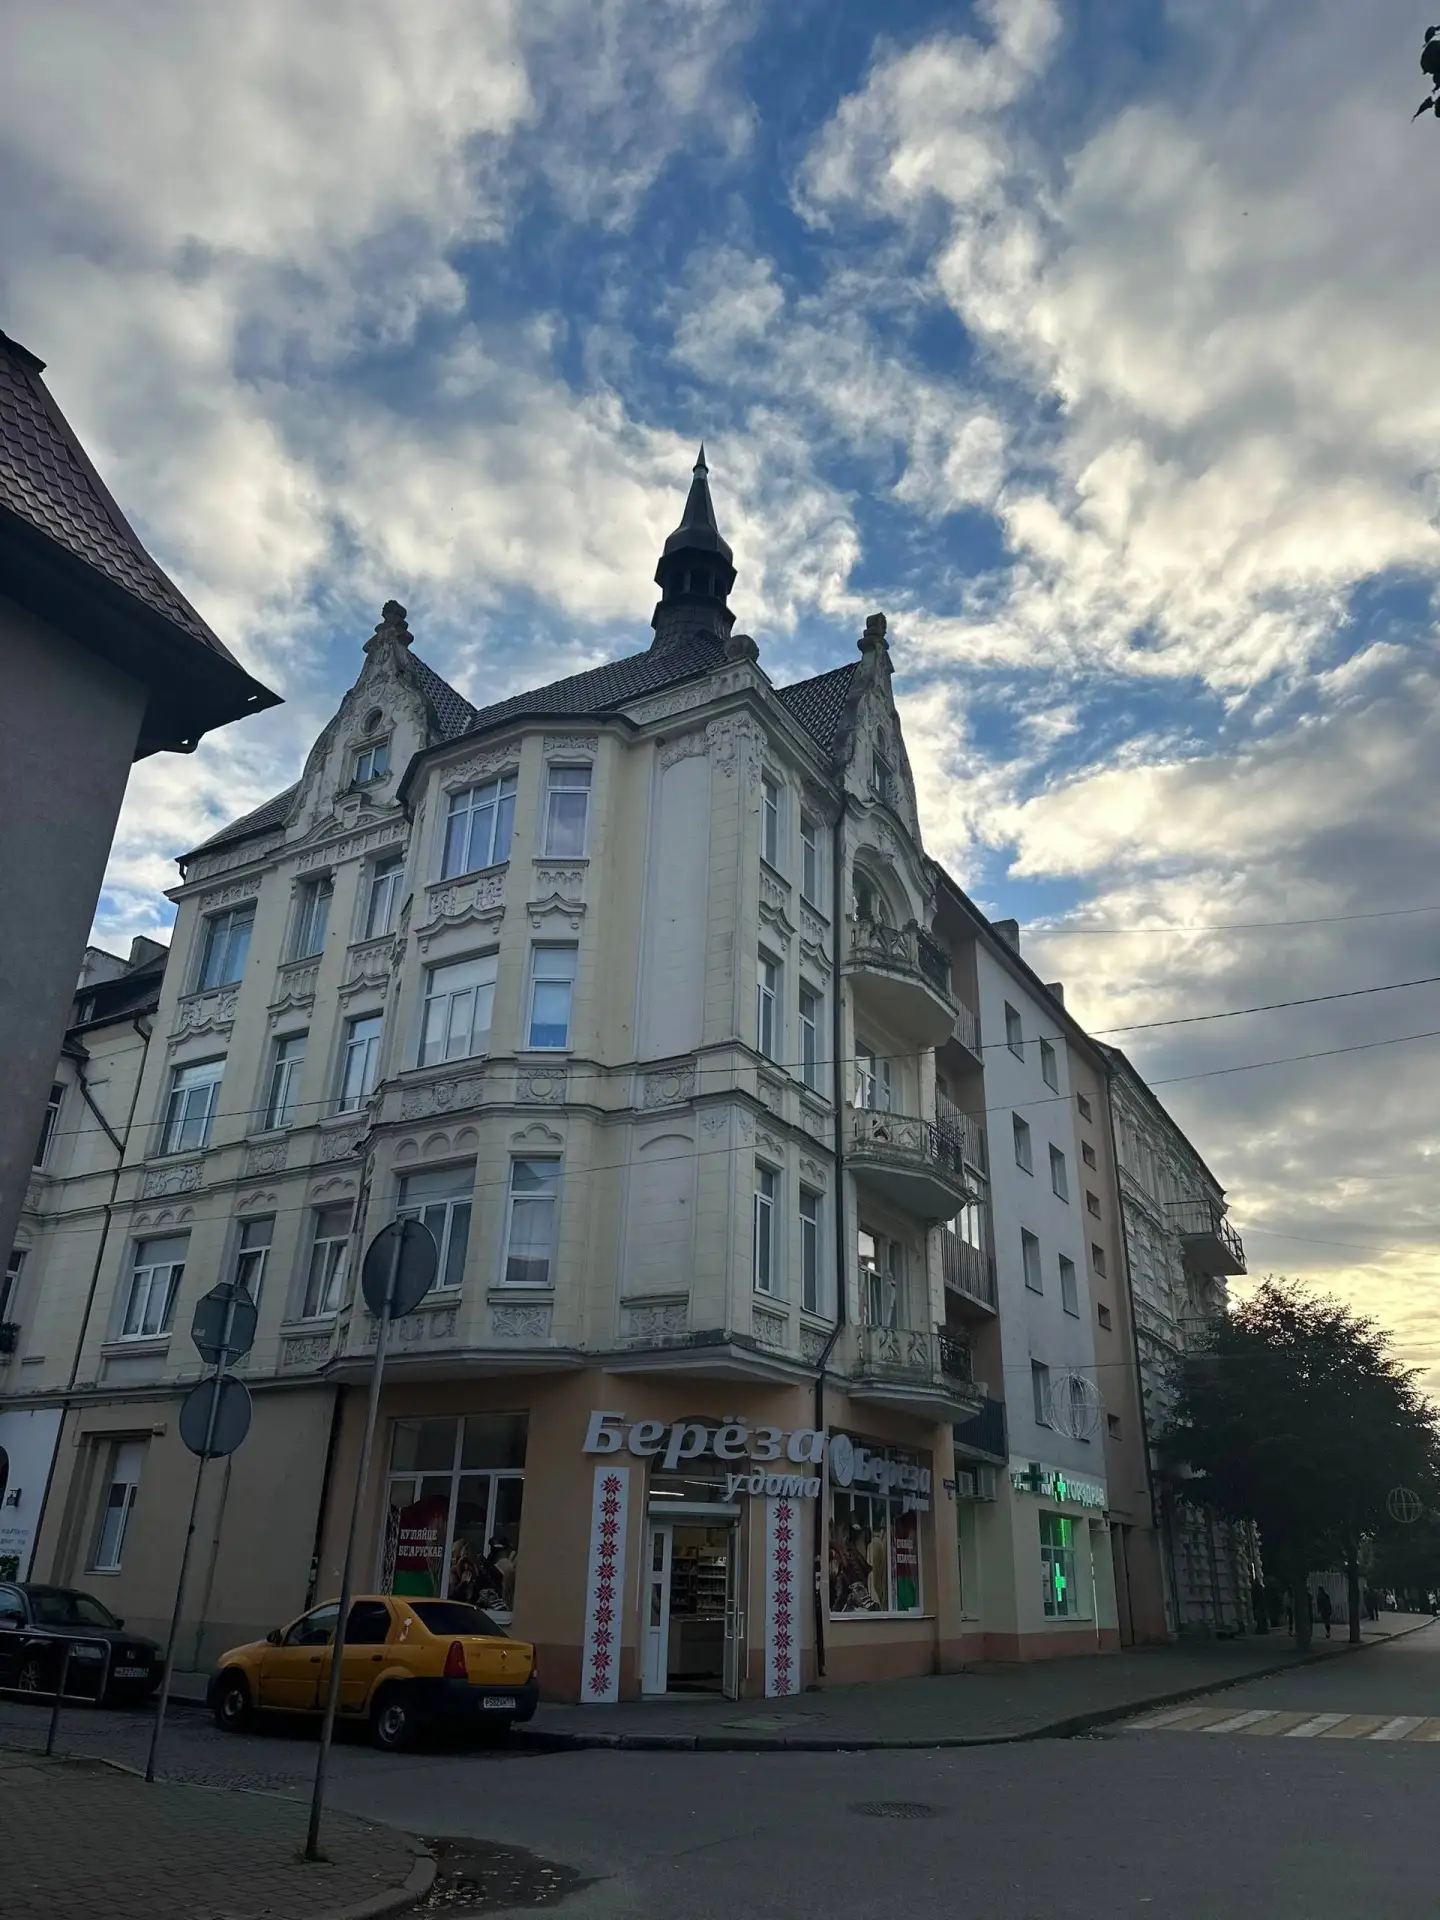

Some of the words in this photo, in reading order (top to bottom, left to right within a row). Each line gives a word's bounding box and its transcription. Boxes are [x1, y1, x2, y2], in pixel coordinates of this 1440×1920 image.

[581, 1410, 826, 1470] Берёза
[725, 1472, 743, 1502] у
[748, 1466, 822, 1498] дома
